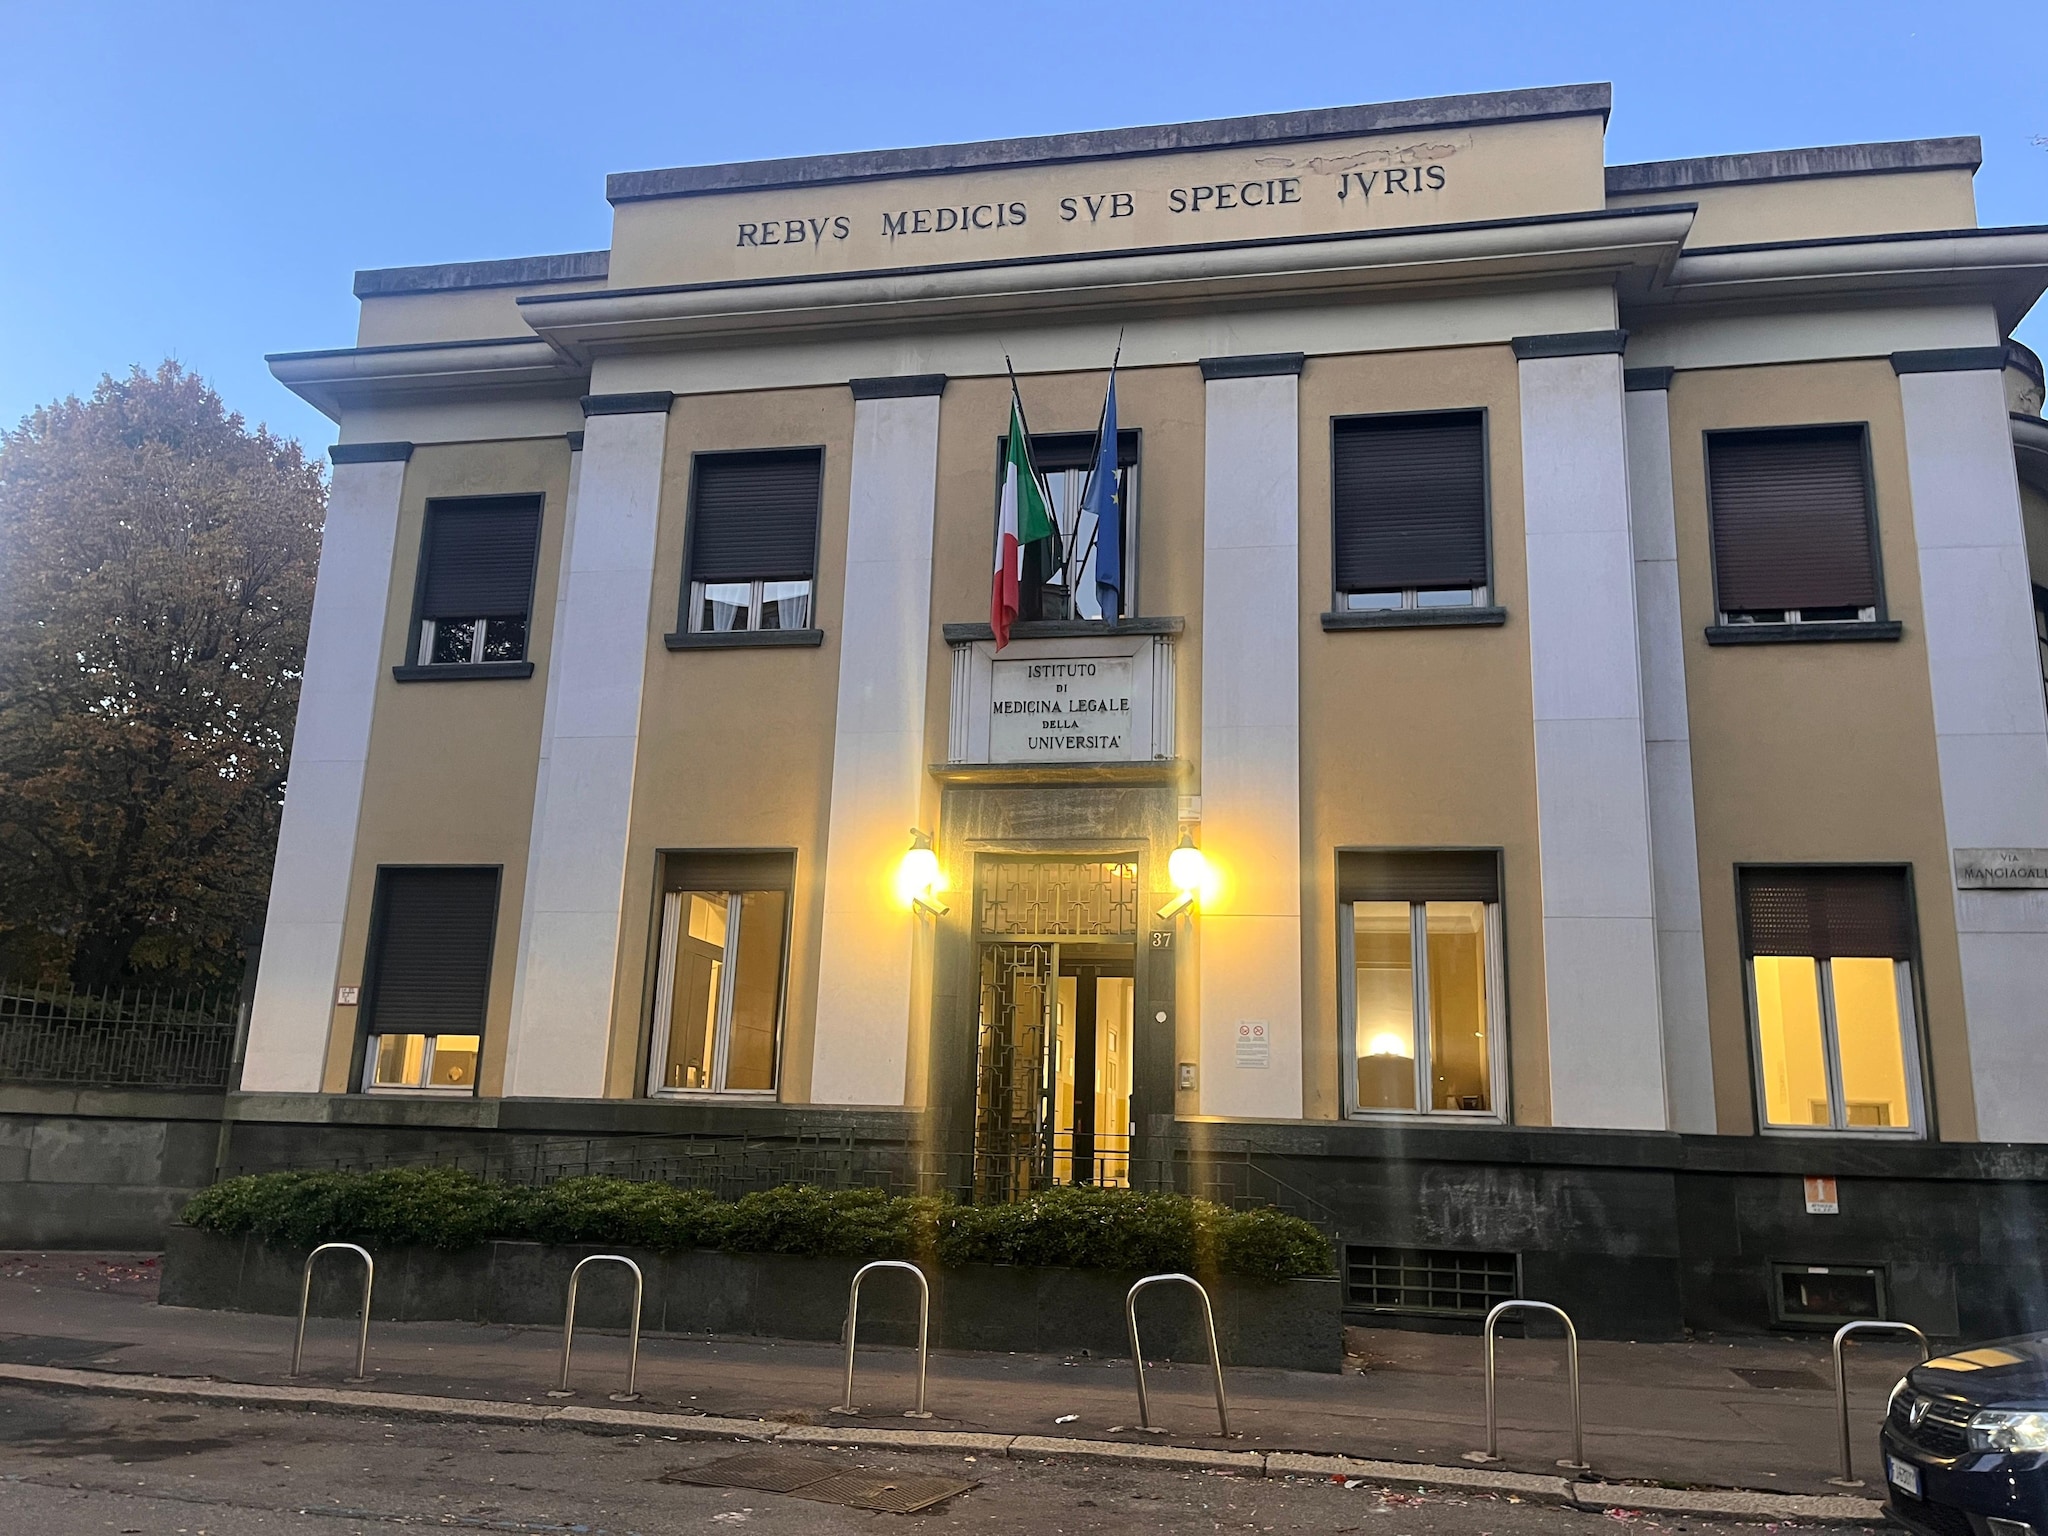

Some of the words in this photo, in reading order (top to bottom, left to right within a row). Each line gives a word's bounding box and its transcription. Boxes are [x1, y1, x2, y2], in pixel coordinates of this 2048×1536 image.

[736, 216, 851, 246] REBVS
[881, 202, 1027, 237] MEDICIS
[1059, 193, 1134, 222] SVB
[1168, 178, 1302, 213] SPECIE
[1337, 165, 1446, 199] JVRIS
[1028, 664, 1096, 678] ISTITUTO
[1056, 684, 1068, 693] DI
[993, 700, 1062, 714] MEDICINA
[1069, 698, 1130, 713] LEGALE
[1042, 720, 1079, 729] DELLA
[1028, 735, 1121, 750] UNIVERSITA'
[2000, 854, 2020, 862] VIA
[1152, 932, 1171, 948] 37
